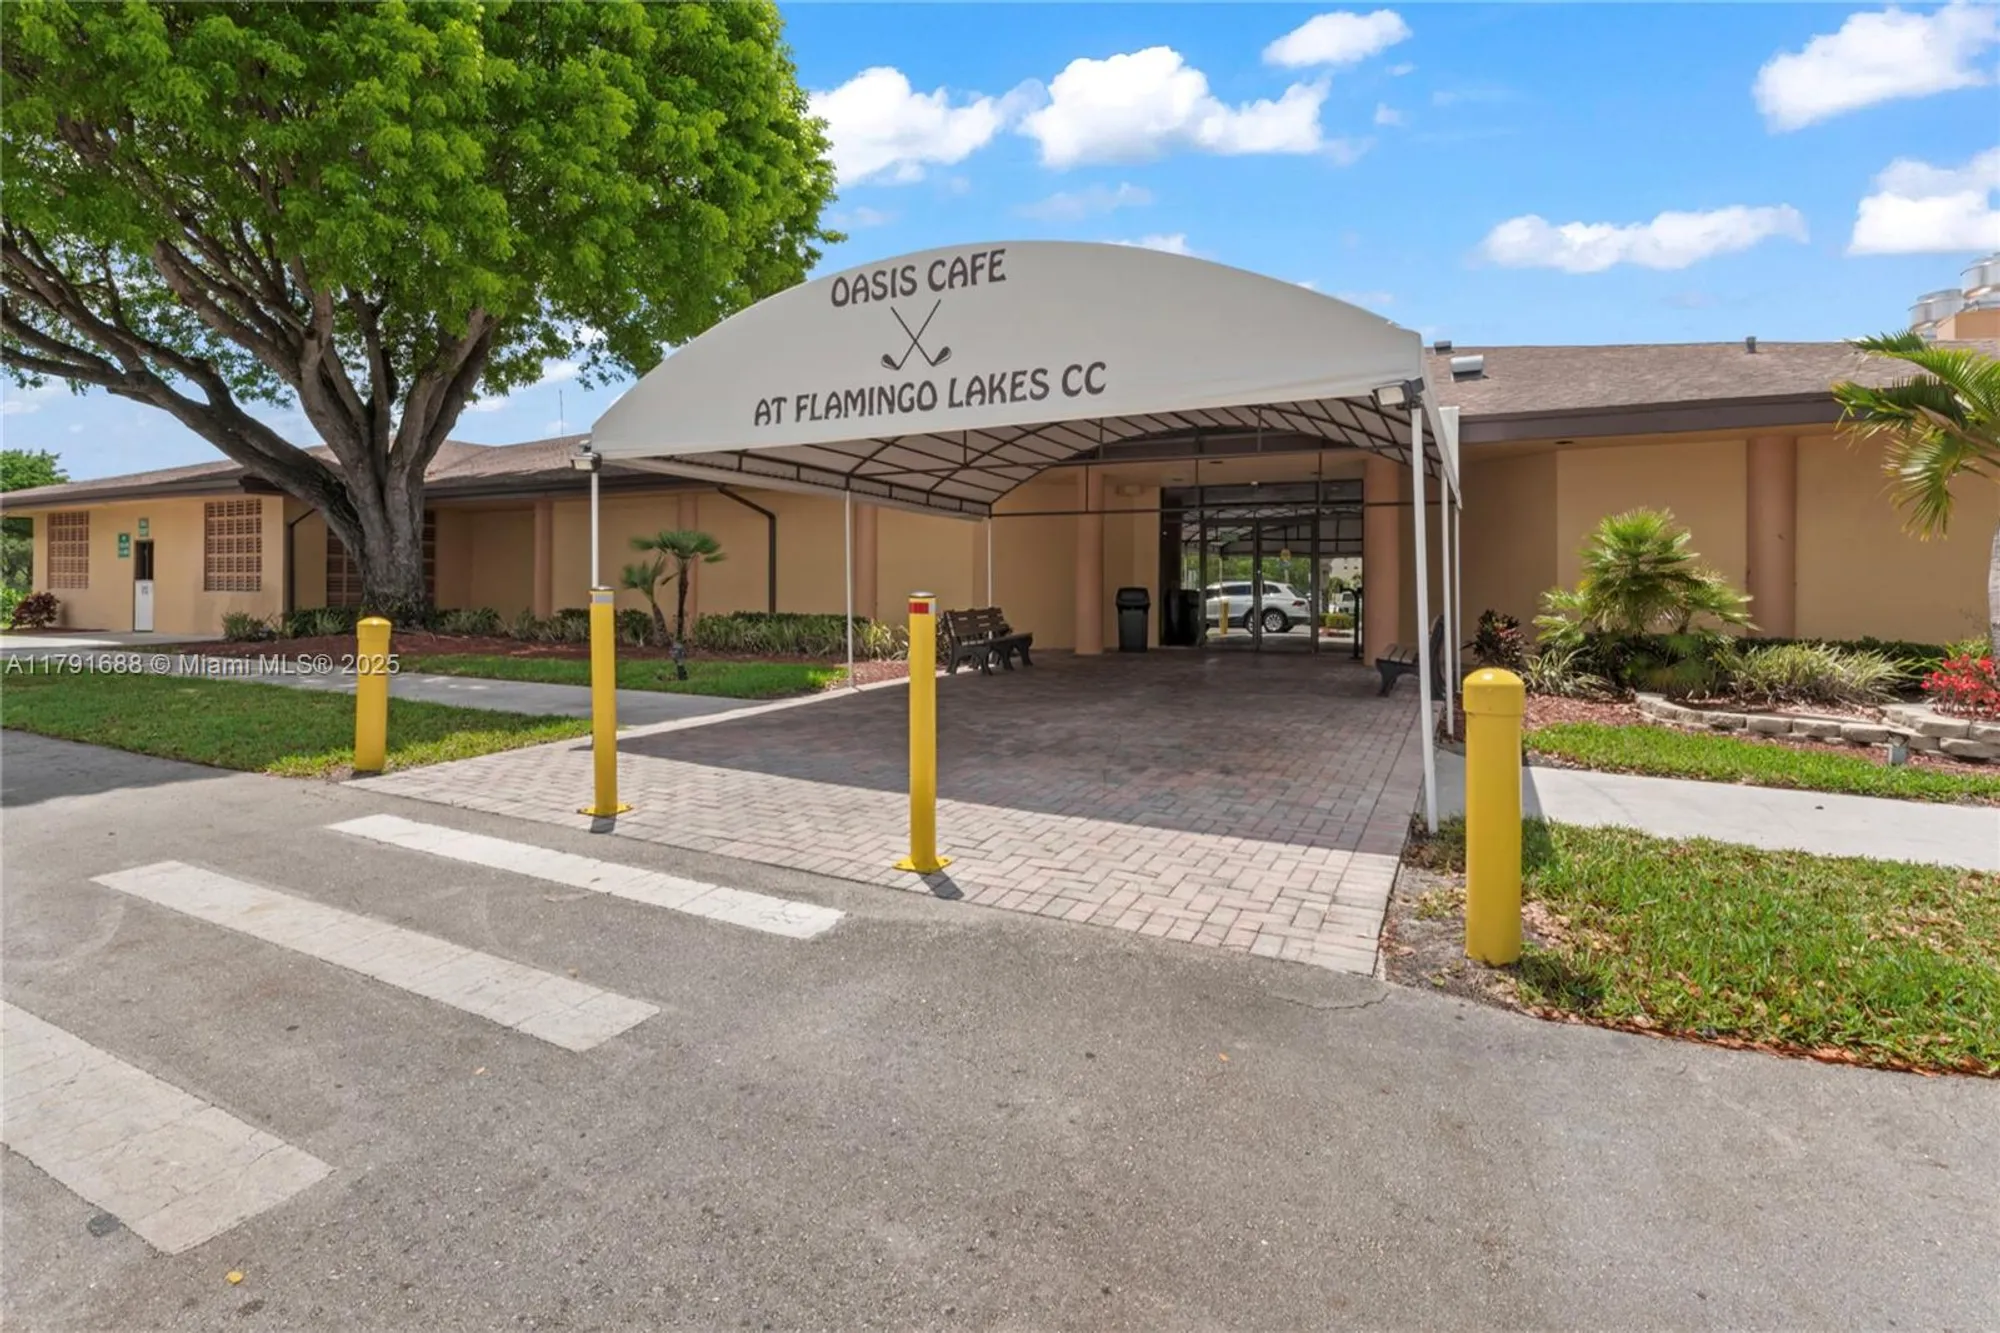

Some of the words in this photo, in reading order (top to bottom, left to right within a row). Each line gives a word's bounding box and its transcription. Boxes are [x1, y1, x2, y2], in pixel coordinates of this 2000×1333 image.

[831, 264, 918, 308] OASIS
[927, 249, 1007, 292] CAFE
[754, 396, 787, 426] AT
[795, 380, 938, 423] FLAMINGO
[948, 368, 1050, 408] LAKES
[1061, 361, 1107, 398] CC
